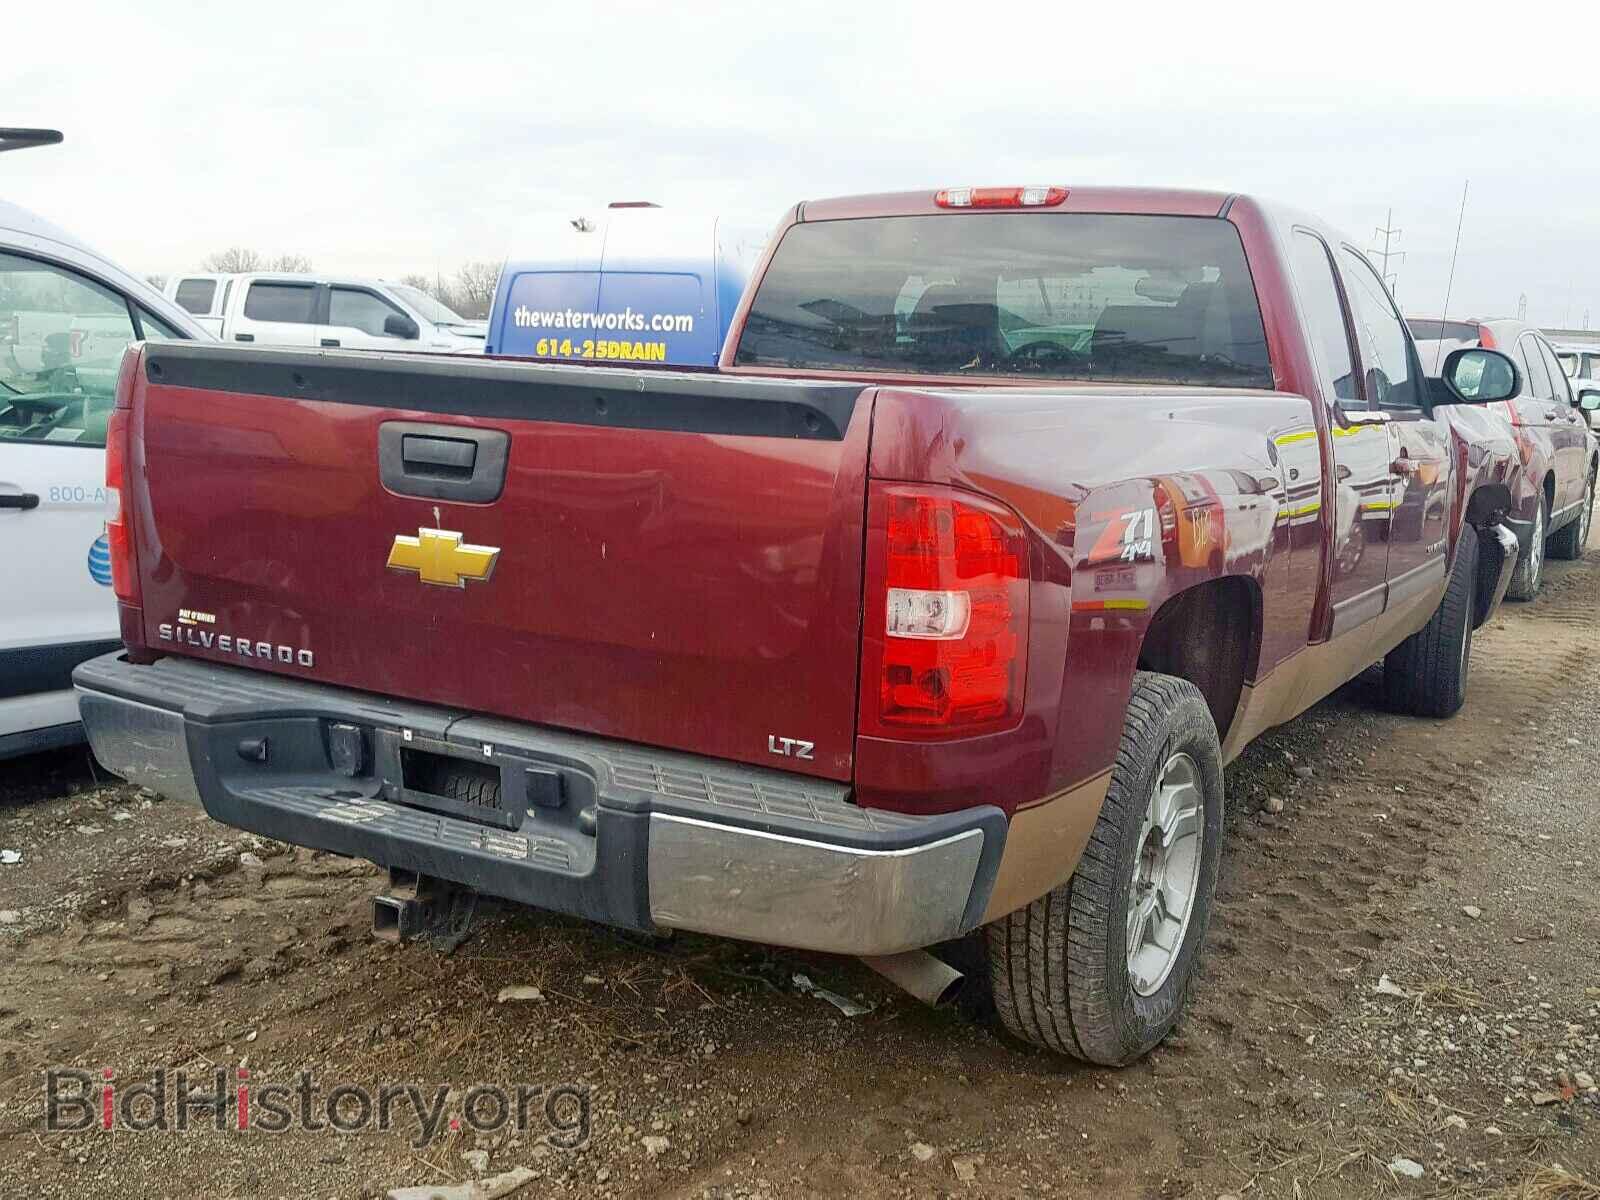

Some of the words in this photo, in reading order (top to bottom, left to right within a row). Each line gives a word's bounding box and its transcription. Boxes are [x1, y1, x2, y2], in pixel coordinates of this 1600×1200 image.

[514, 305, 693, 332] thewaterworks.com
[536, 338, 666, 361] 614-25DRAIN
[1088, 508, 1153, 561] Z71
[158, 623, 313, 667] SILVERADO
[768, 735, 815, 760] LTZ
